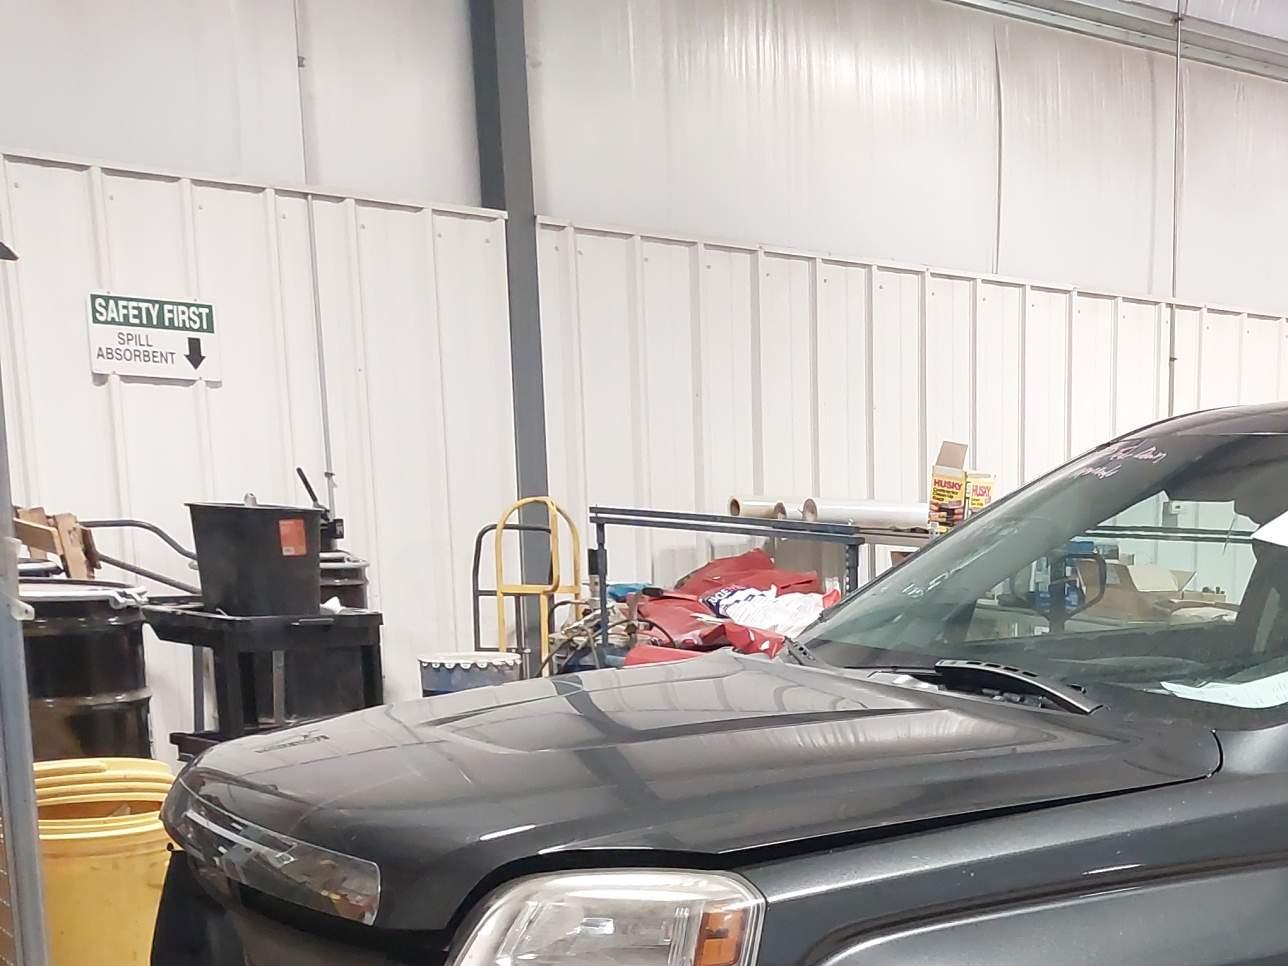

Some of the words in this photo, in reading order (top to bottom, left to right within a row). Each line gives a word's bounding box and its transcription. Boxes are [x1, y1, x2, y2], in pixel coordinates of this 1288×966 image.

[95, 298, 160, 325] SAFETY
[163, 304, 210, 329] FIRST
[117, 332, 154, 347] SPILL
[96, 347, 176, 365] ABSORBENT
[934, 479, 963, 491] HUSKY
[972, 484, 992, 497] HUSKY
